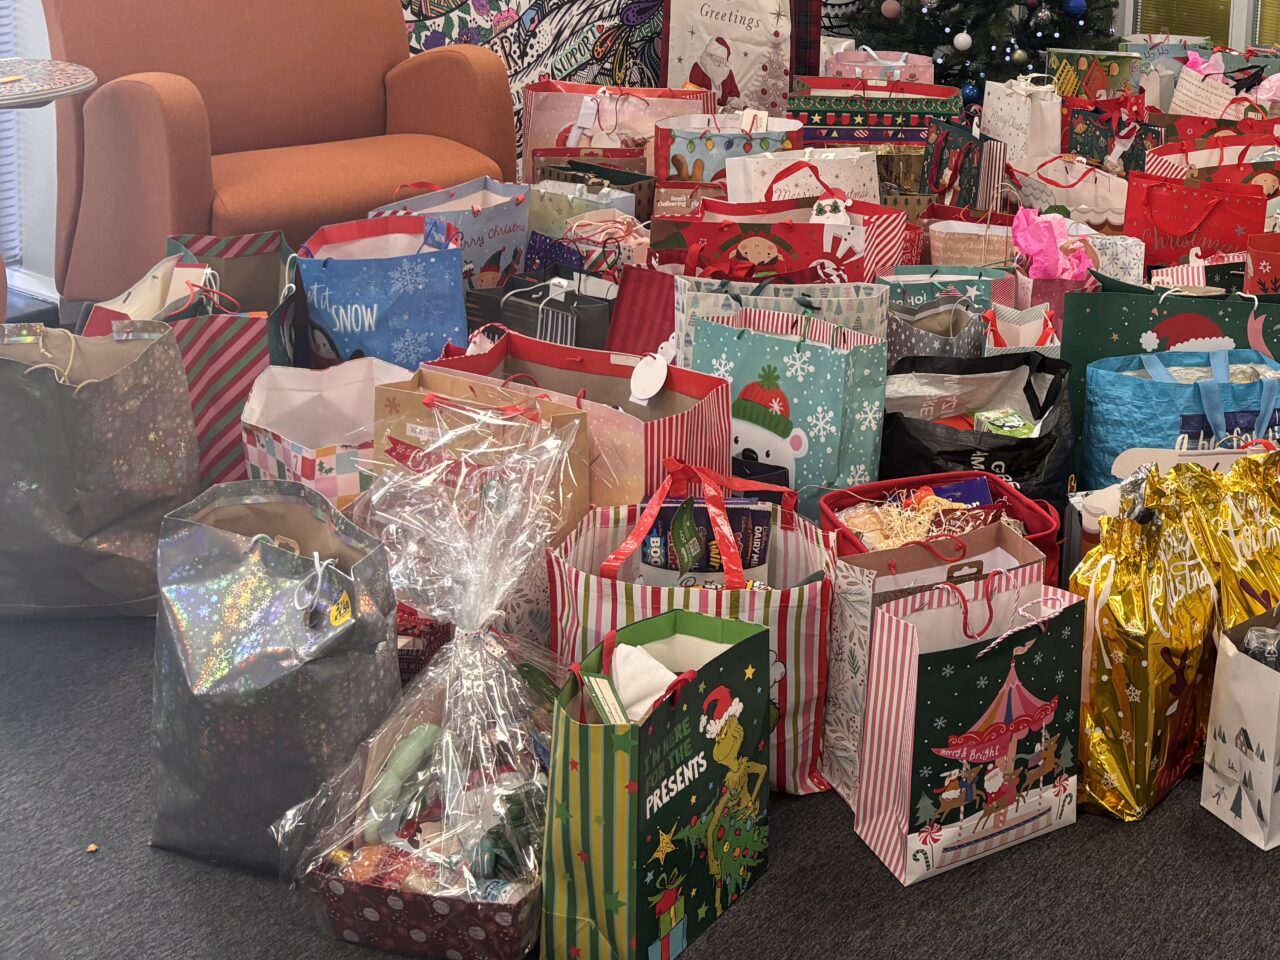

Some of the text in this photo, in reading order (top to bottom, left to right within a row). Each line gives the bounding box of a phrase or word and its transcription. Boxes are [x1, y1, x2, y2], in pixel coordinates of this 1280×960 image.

[699, 2, 762, 31] Greetings
[551, 24, 599, 78] SUPPORT
[332, 303, 379, 333] SNOW
[649, 537, 662, 566] BOO
[753, 525, 763, 553] DAIRY
[668, 738, 693, 771] THE
[969, 744, 1000, 761] Bright
[646, 750, 708, 821] PRESENTS
